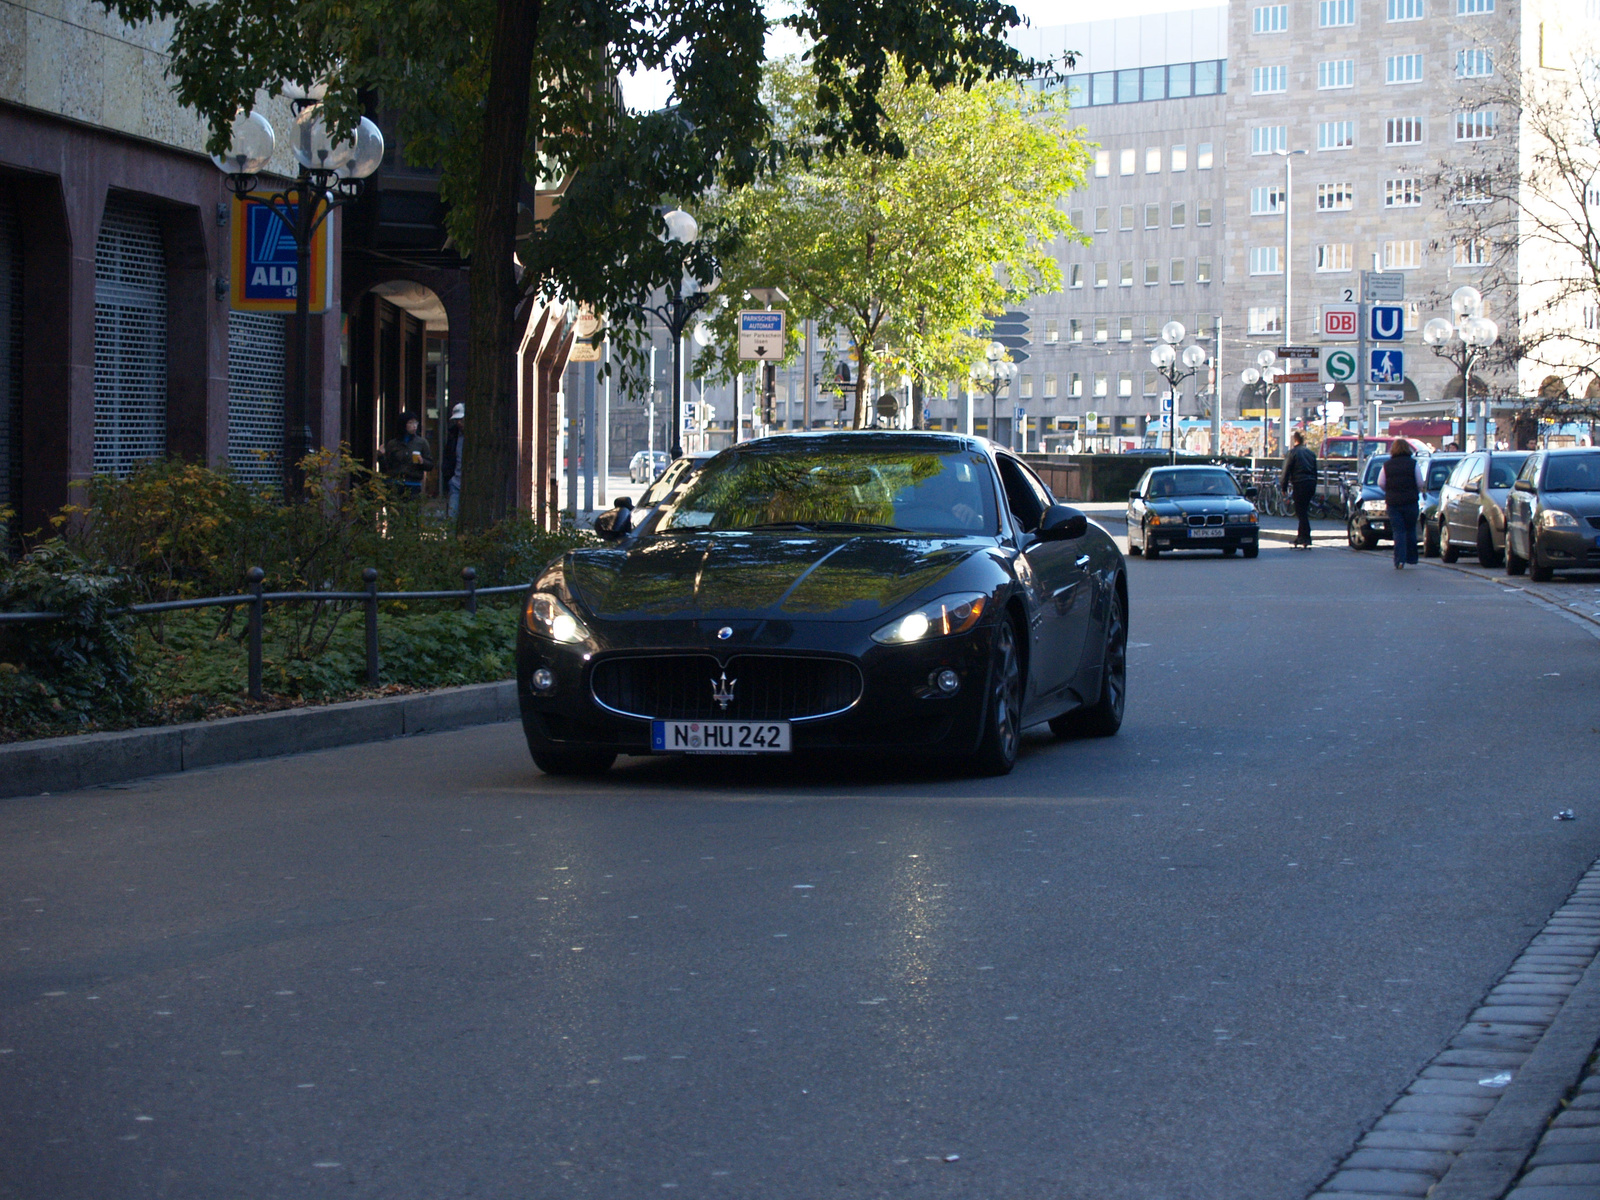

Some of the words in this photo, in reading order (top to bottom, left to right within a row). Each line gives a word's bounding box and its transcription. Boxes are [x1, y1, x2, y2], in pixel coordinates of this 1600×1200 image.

[251, 266, 298, 286] ALD
[285, 286, 298, 297] SÜ
[1343, 289, 1353, 302] 2
[1329, 315, 1352, 331] DB
[1376, 310, 1398, 337] U
[1331, 353, 1351, 379] S
[656, 737, 663, 745] D
[674, 724, 689, 747] N
[703, 725, 733, 748] HU
[738, 725, 781, 748] 242
